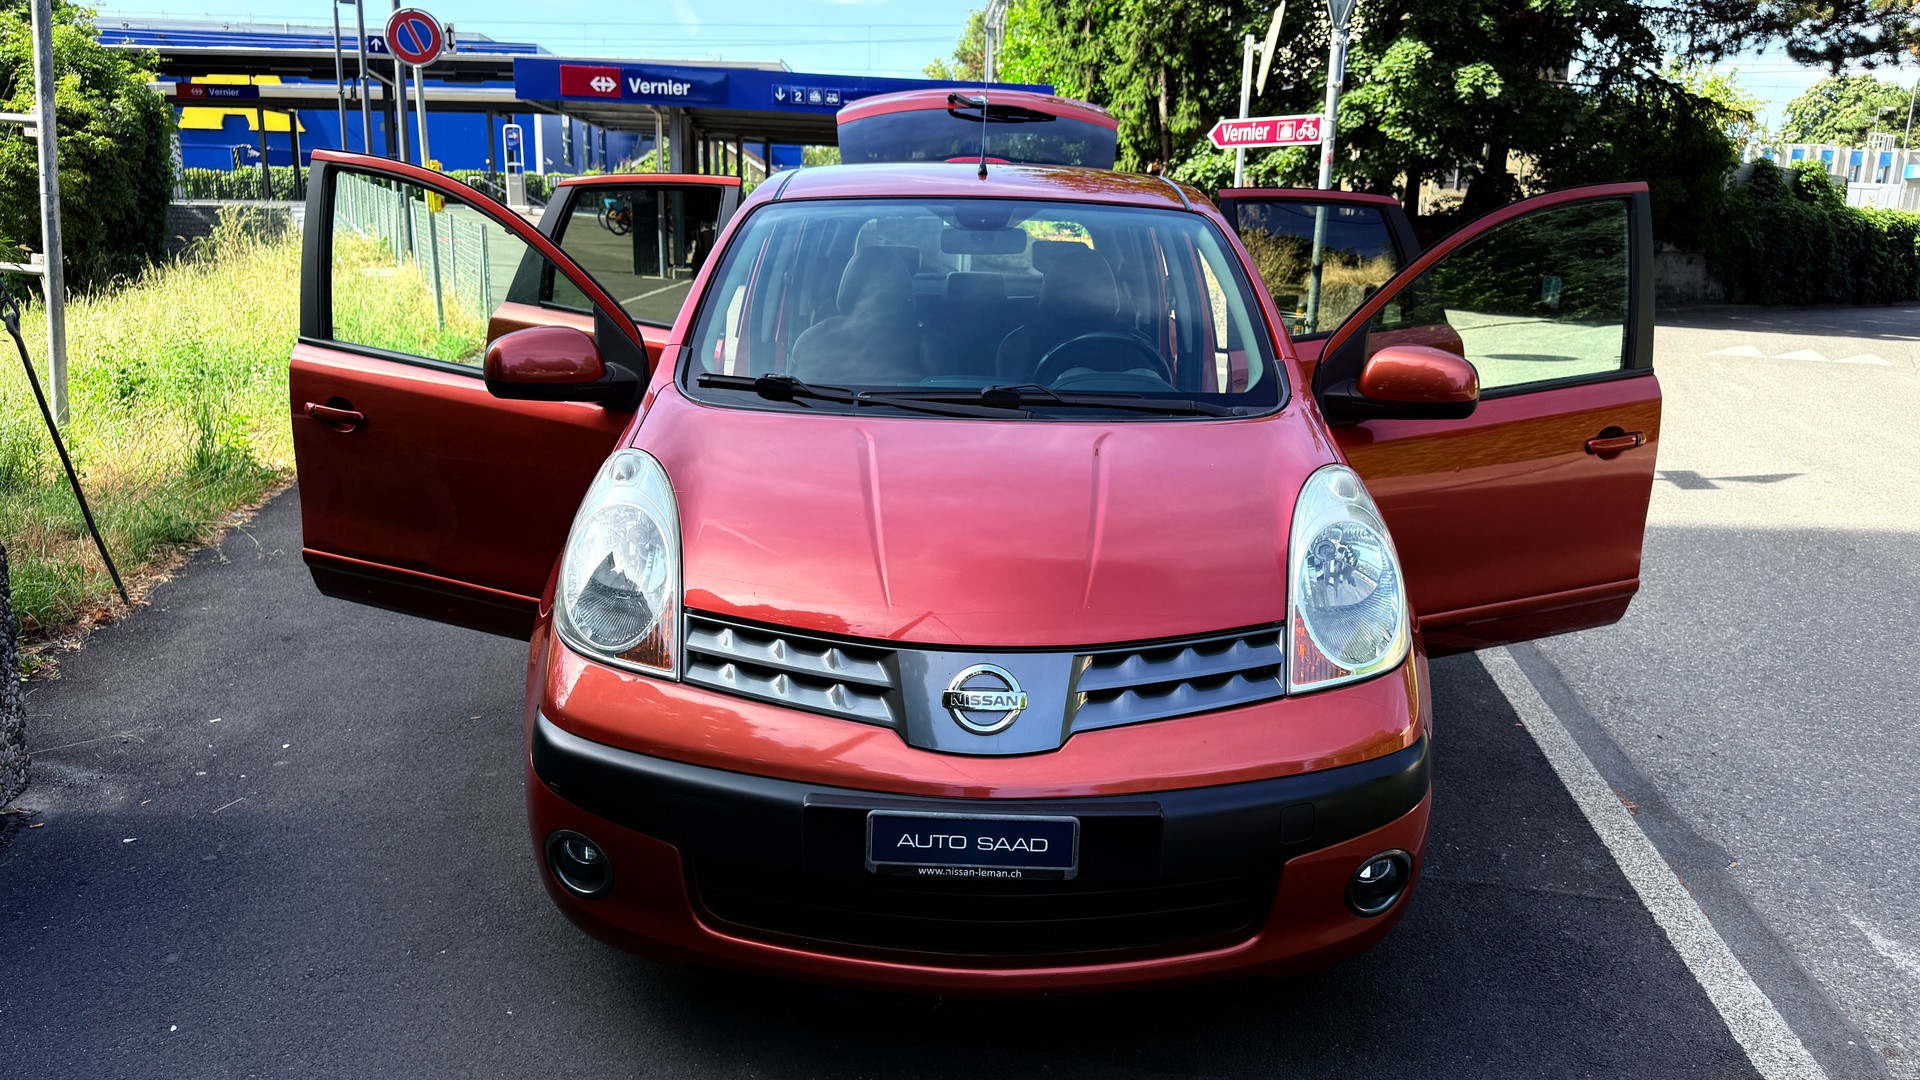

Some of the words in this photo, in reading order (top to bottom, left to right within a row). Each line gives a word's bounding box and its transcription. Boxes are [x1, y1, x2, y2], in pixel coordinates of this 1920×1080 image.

[208, 87, 240, 97] Vernier
[628, 77, 691, 96] Vernier
[795, 91, 802, 102] 2
[1221, 122, 1270, 142] Vernier
[950, 694, 1018, 706] NISSAN
[896, 833, 967, 849] AUTO
[977, 837, 1049, 852] SAAD
[918, 867, 1022, 878] www.nissan-leman.ch
